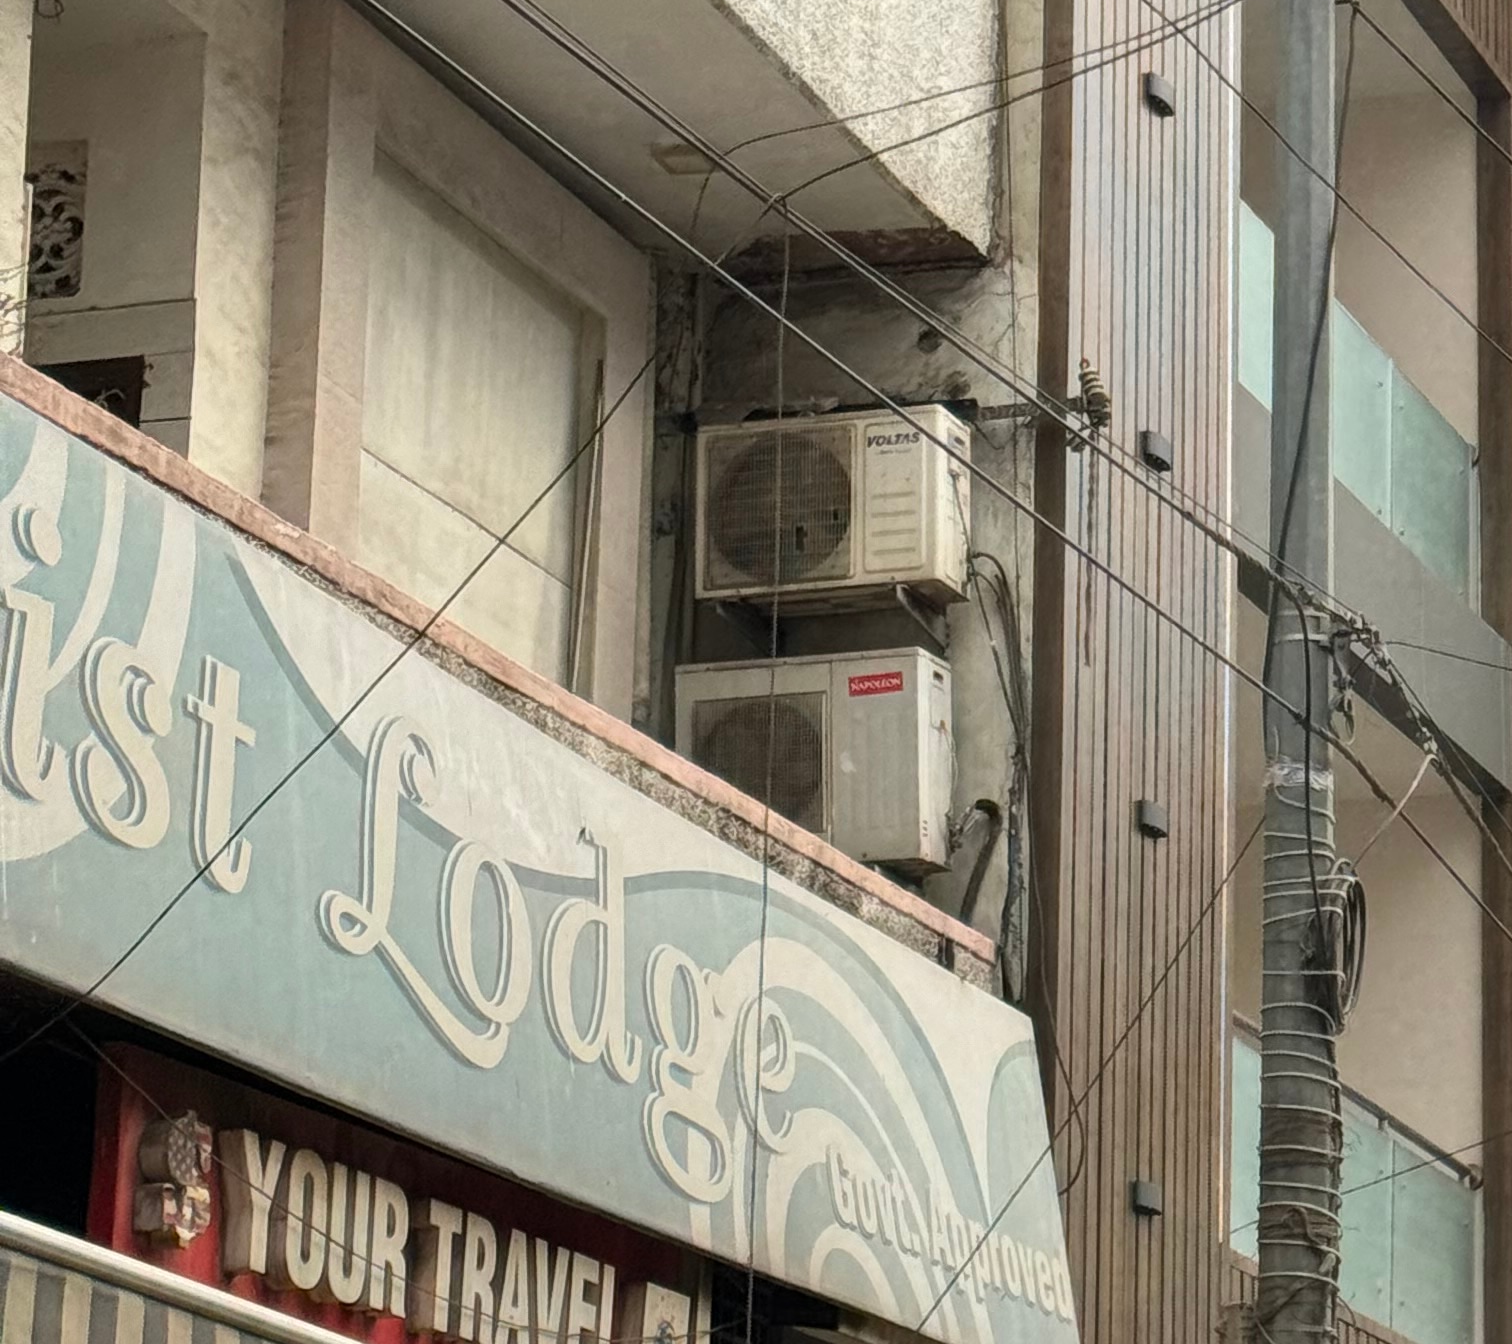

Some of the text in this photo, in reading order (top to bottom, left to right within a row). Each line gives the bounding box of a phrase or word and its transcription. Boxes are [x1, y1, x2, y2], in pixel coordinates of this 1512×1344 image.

[867, 431, 920, 449] VOLTAS
[318, 714, 796, 1203] Lodge
[240, 1127, 408, 1319] YOUR
[827, 1144, 1073, 1324] Govt. Approved
